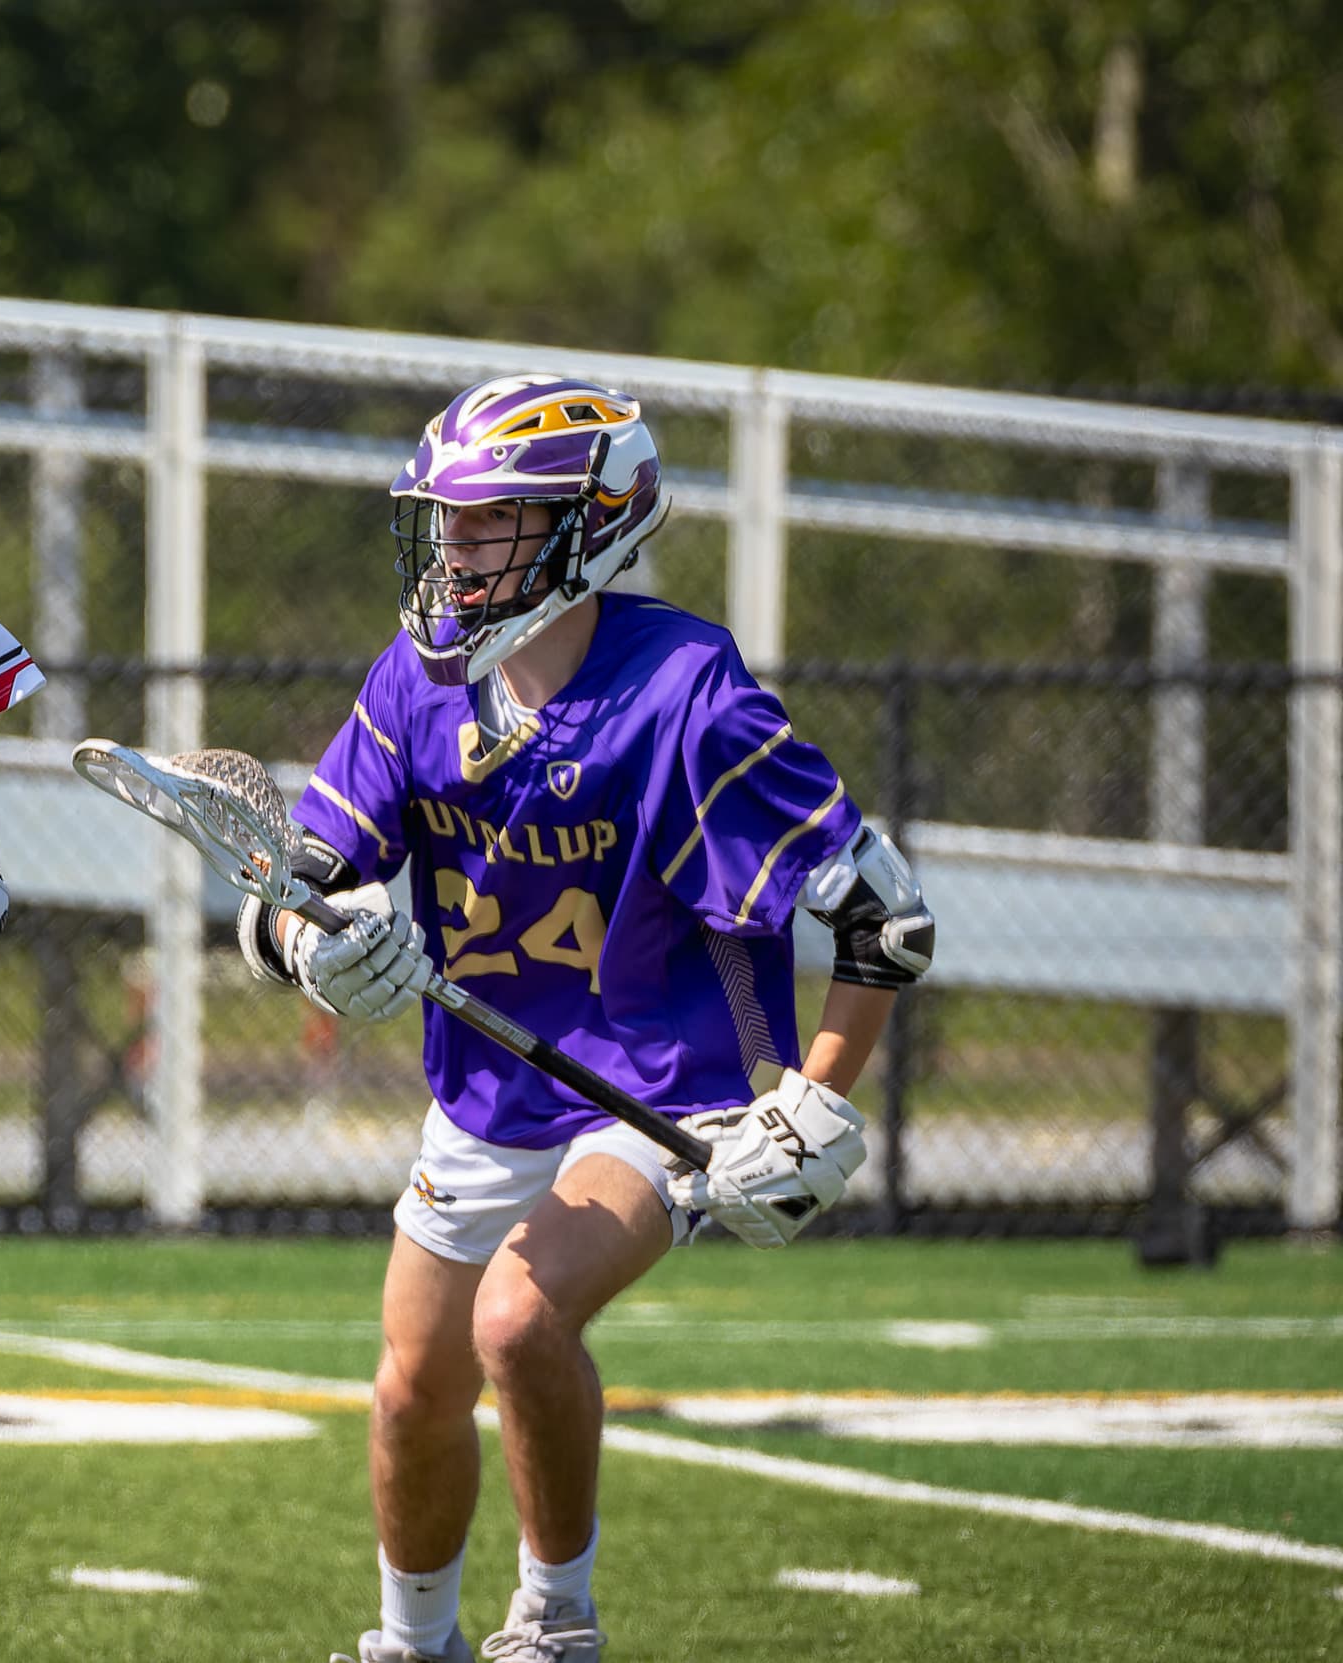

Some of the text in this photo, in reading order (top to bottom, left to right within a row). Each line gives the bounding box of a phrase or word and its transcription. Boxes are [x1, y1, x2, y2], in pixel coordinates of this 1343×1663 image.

[410, 797, 617, 866] UYALLUP
[435, 867, 607, 994] 24
[757, 1106, 820, 1170] STX
